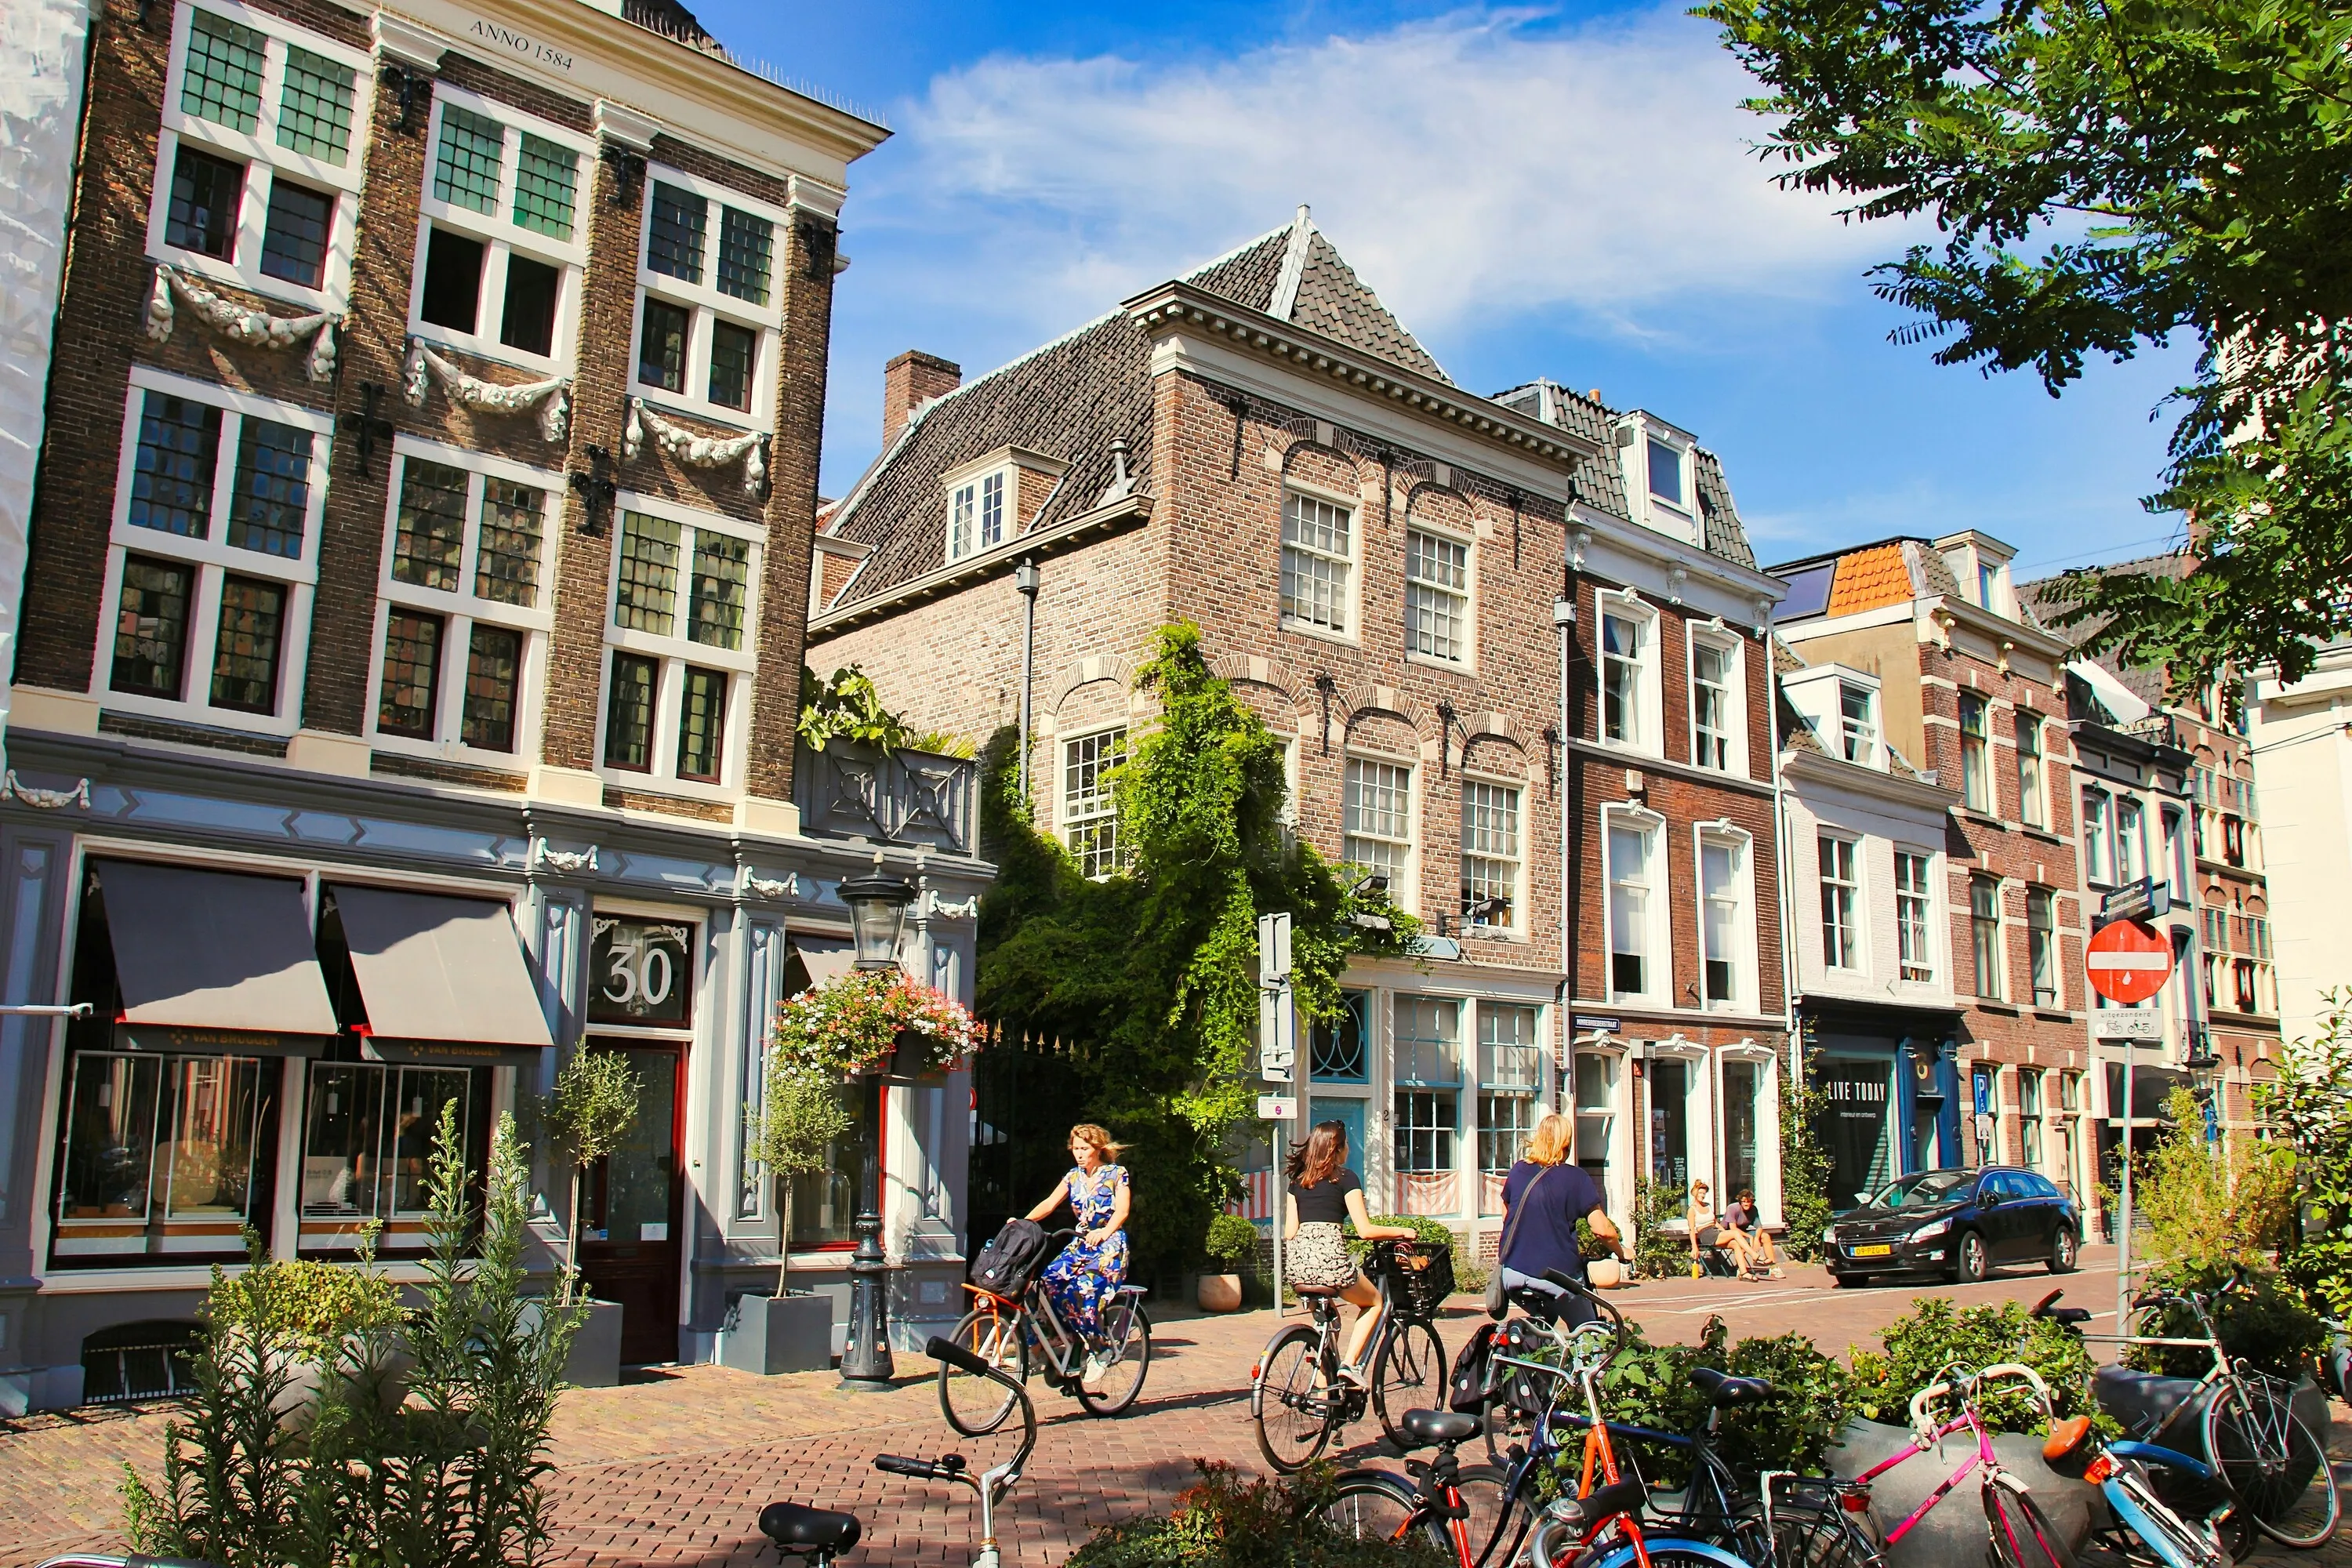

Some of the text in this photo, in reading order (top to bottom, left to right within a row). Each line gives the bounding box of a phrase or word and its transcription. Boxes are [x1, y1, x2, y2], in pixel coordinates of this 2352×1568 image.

[470, 20, 572, 71] ANNO 1584
[603, 946, 672, 1005] 30
[193, 1033, 216, 1044] VAN
[1828, 1081, 1885, 1102] LIVE TODAY
[1978, 1078, 1985, 1098] P
[1383, 1109, 1389, 1121] 2
[1856, 1246, 1887, 1255] 09-PZG-6
